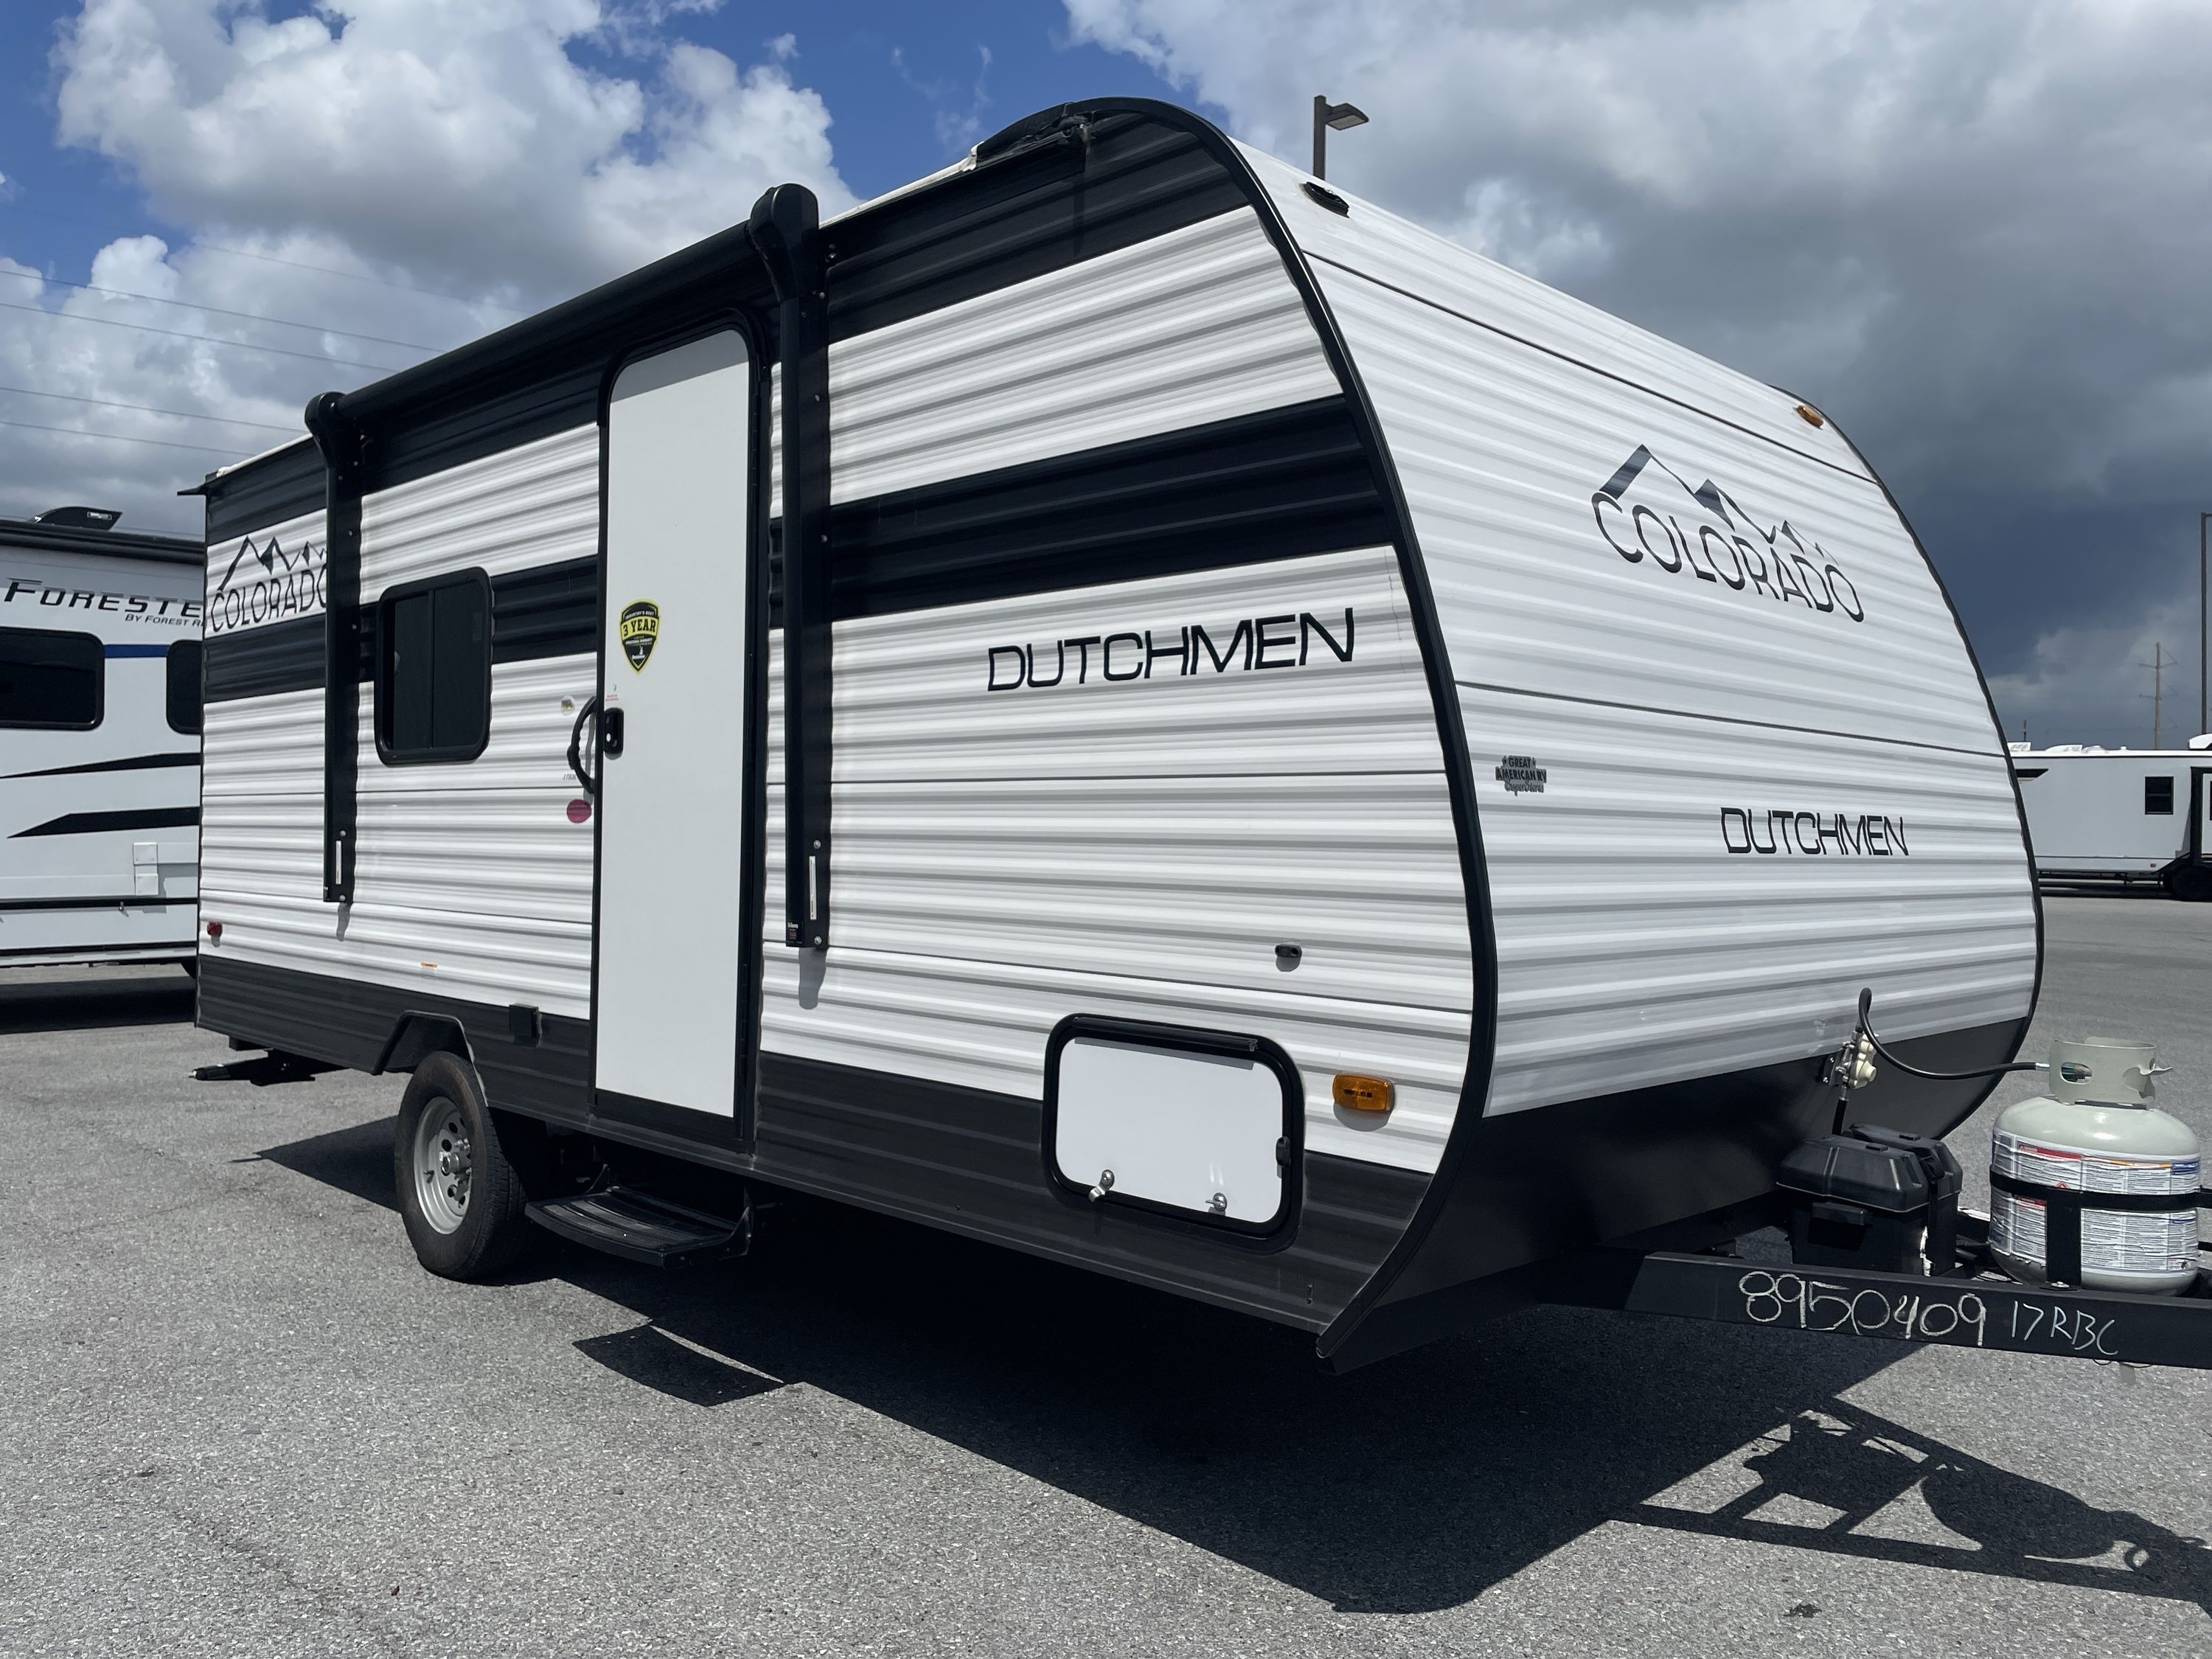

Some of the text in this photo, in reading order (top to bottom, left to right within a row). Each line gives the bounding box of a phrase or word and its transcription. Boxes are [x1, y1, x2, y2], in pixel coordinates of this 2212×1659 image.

[1591, 491, 1864, 622] COLORADO
[4, 577, 204, 618] FORESTE
[125, 613, 142, 623] BY
[145, 615, 189, 627] FOREST
[211, 563, 327, 632] COLORADO
[623, 619, 656, 636] 3 YEAR
[988, 608, 1354, 692] DUTCHMEN
[1496, 766, 1546, 782] AMERICAN RV
[1509, 757, 1531, 768] GREAT
[1721, 807, 1909, 856] DUTCHMEN
[1739, 1270, 1986, 1347] 8950409
